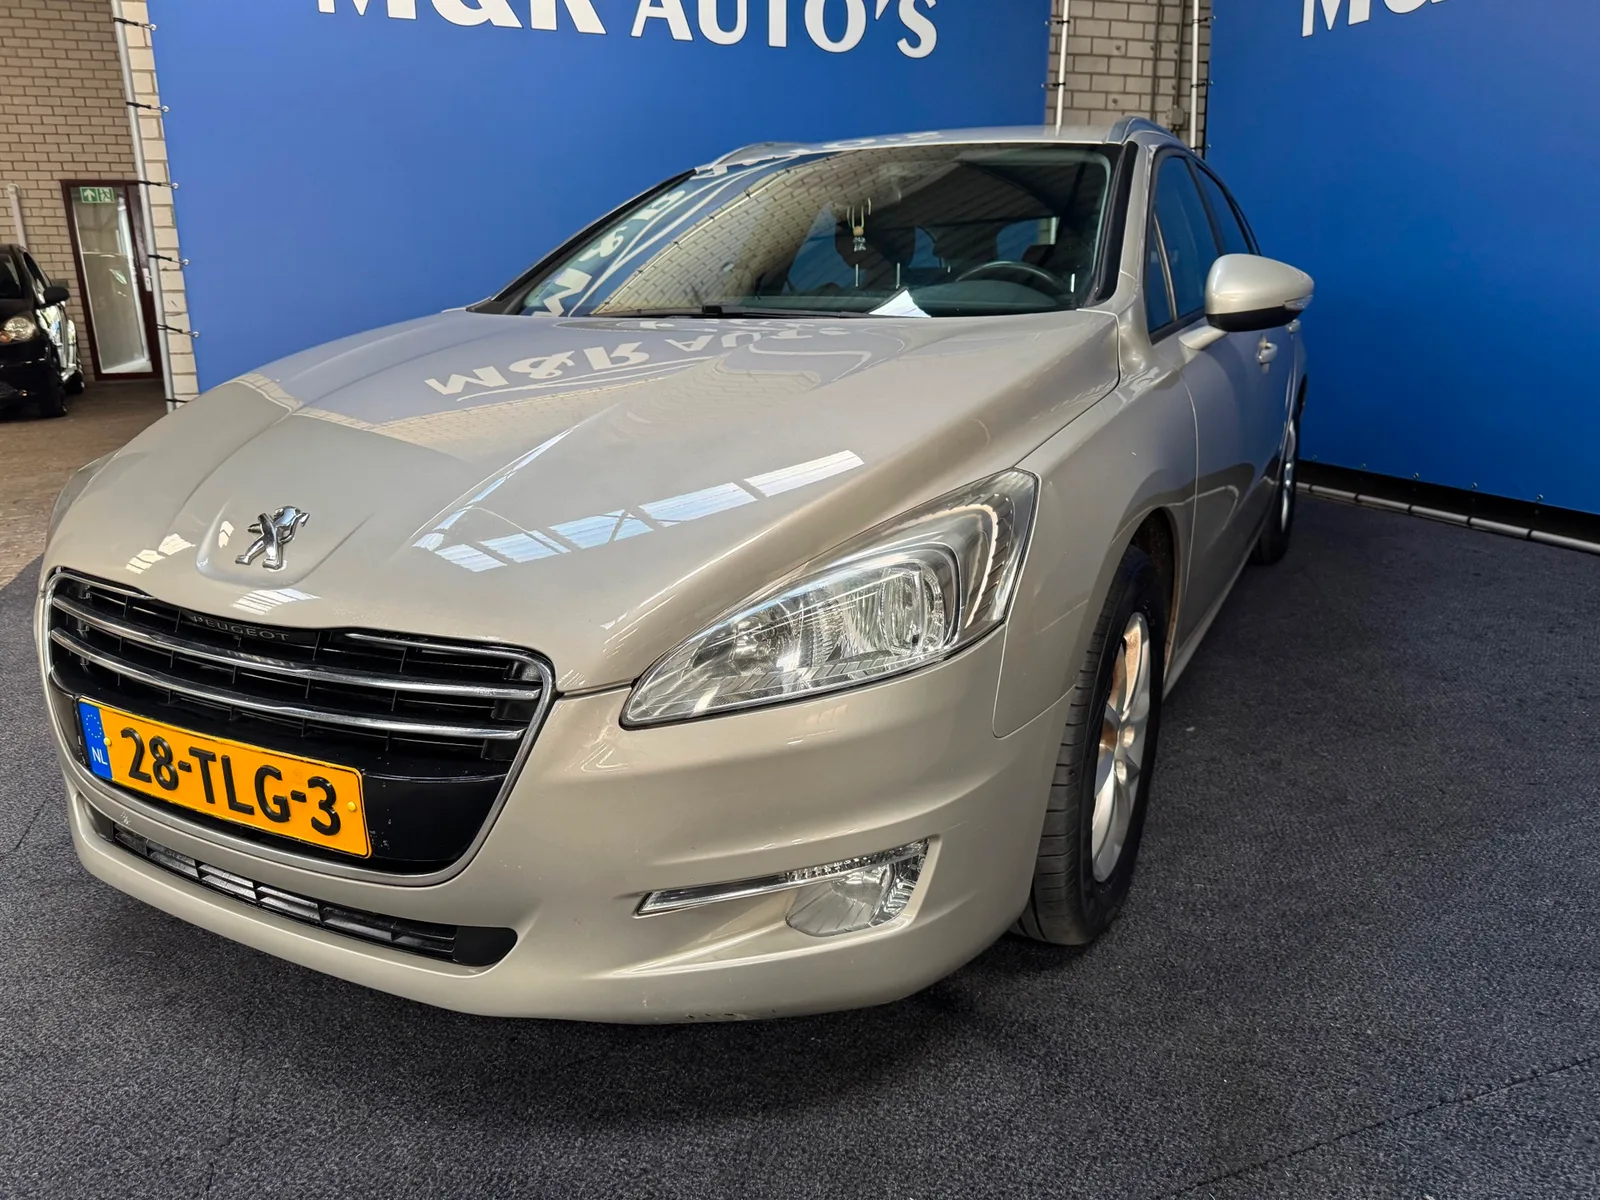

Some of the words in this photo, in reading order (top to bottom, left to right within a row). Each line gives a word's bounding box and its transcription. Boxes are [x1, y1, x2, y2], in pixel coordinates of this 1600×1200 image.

[193, 615, 289, 641] PEUGEOT
[91, 746, 108, 766] NL
[120, 727, 341, 836] 28-TLG-3
